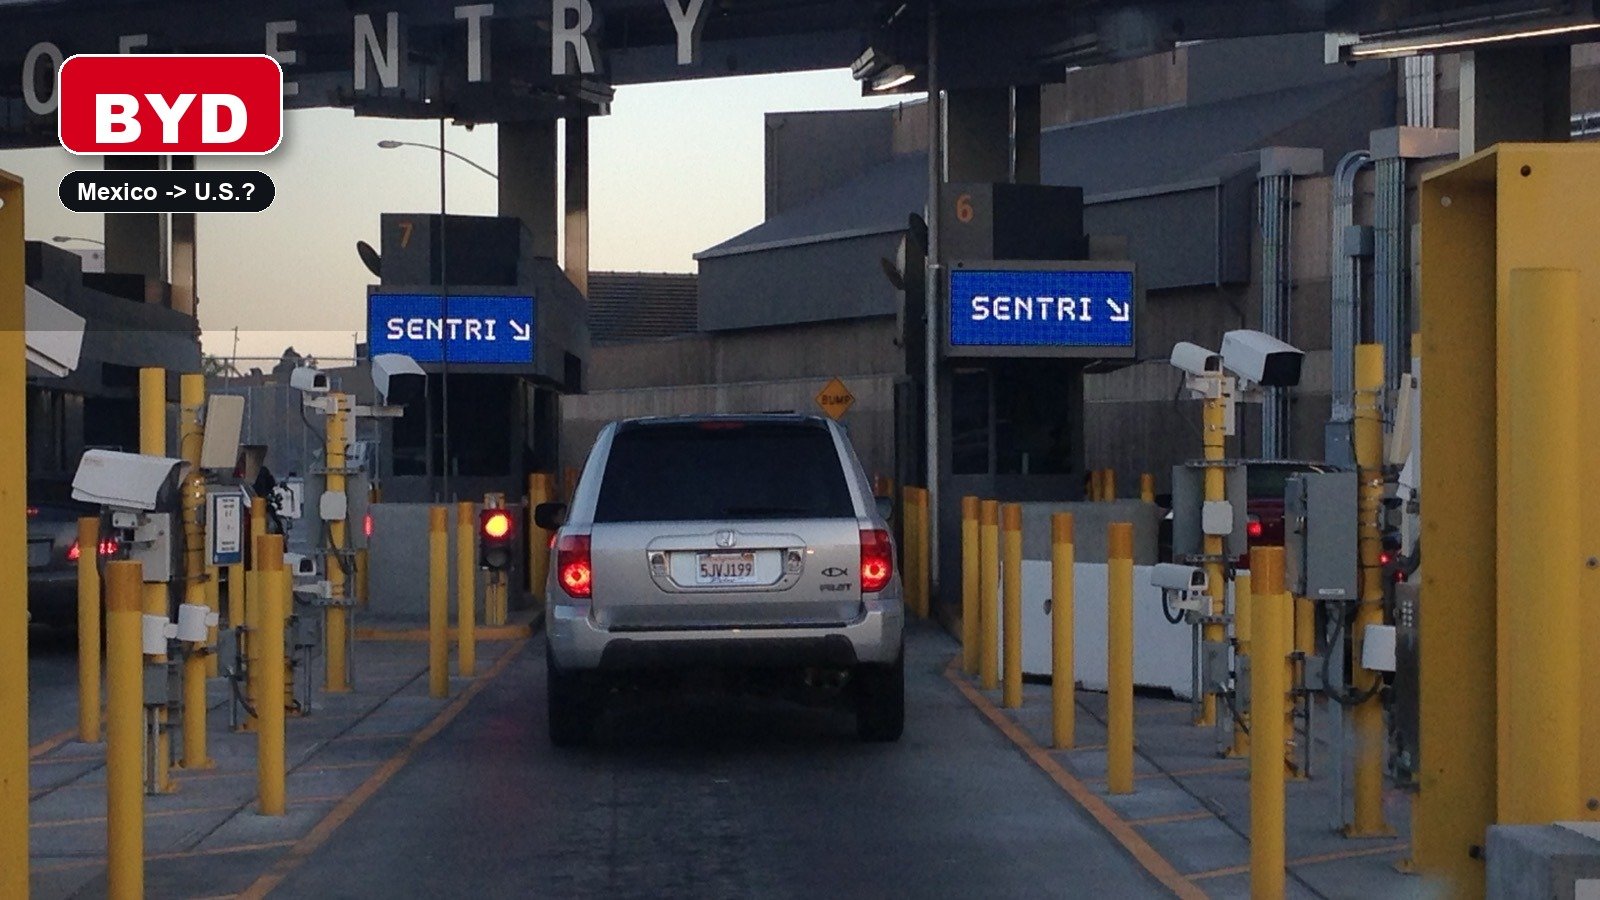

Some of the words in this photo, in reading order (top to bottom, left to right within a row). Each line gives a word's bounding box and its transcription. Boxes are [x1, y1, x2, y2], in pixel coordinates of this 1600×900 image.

[265, 0, 704, 95] ENTRY
[956, 193, 974, 224] 6
[399, 222, 414, 248] 7
[971, 296, 1093, 322] SENTRI
[387, 317, 497, 341] SENTRI
[821, 394, 851, 405] BUMP
[700, 563, 752, 578] 5JVJ199
